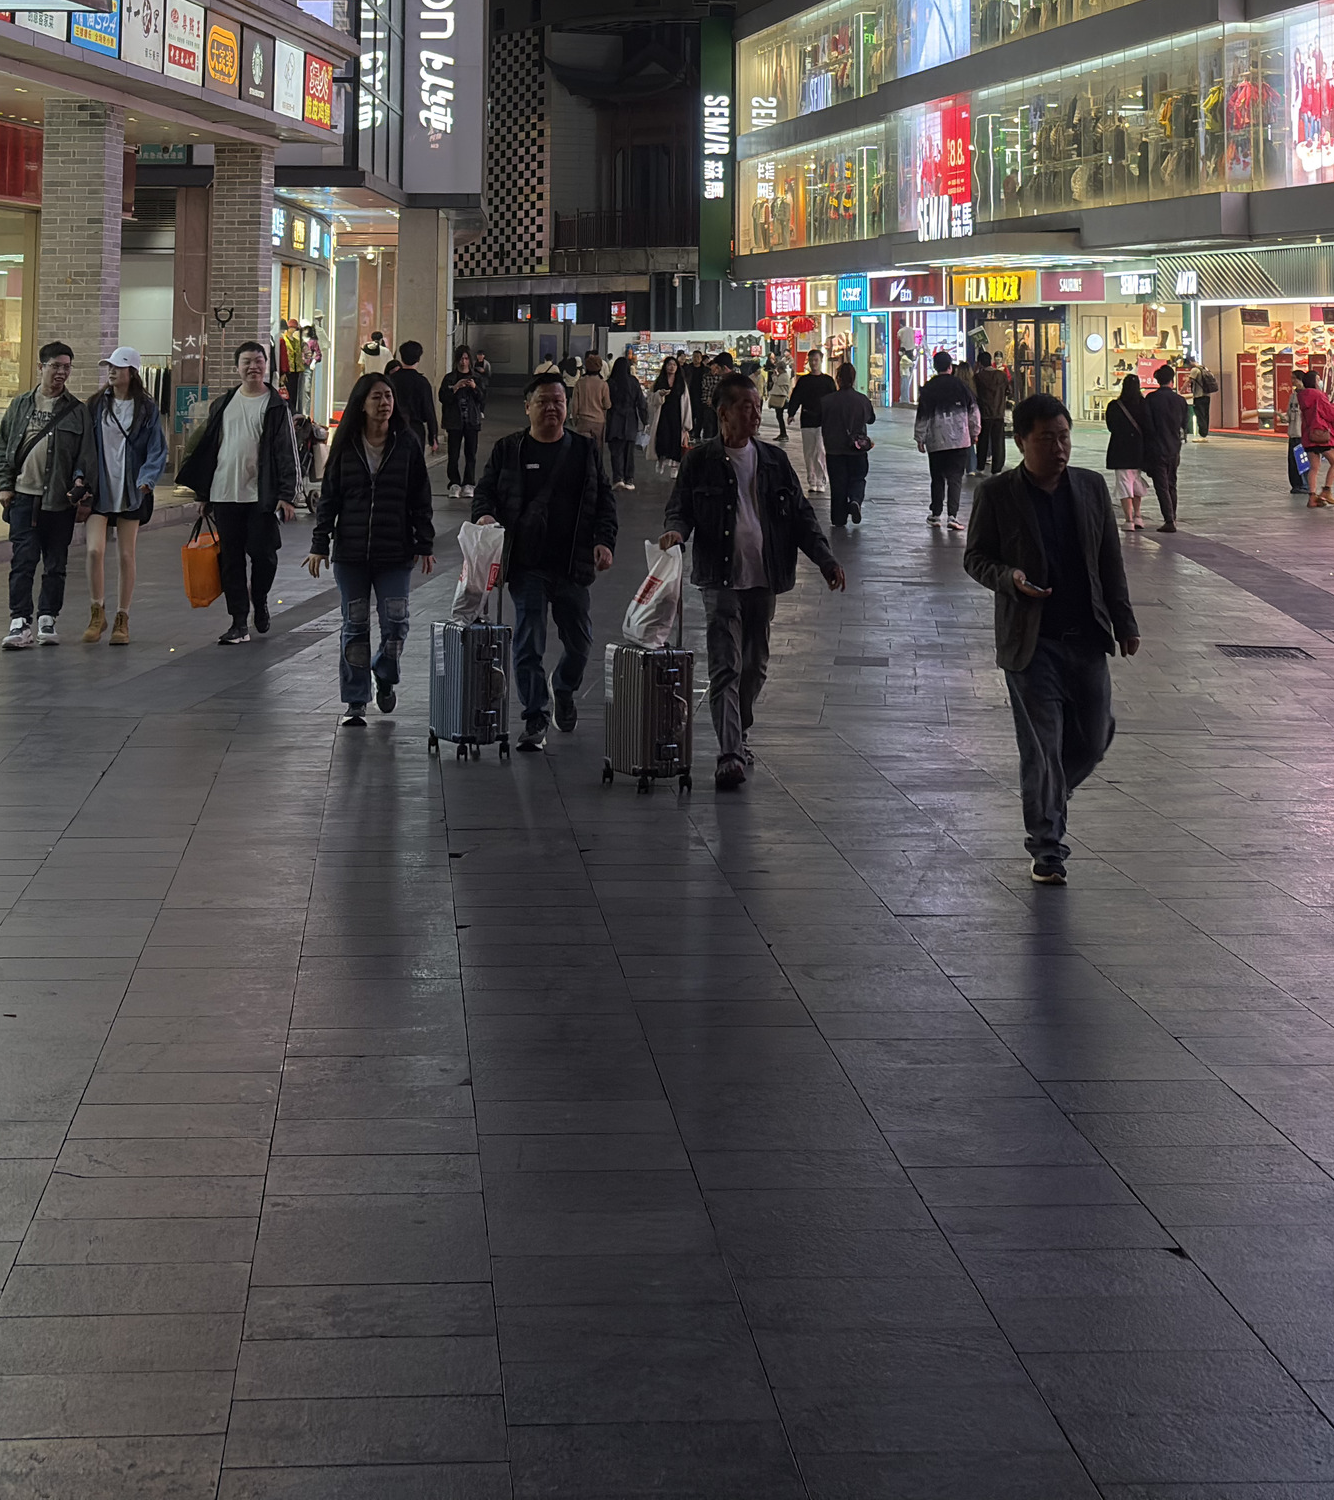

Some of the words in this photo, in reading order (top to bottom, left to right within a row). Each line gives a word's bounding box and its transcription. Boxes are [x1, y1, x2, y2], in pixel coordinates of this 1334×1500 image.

[703, 94, 730, 156] SEMIR
[917, 194, 951, 243] SEMIR
[964, 276, 987, 302] HLA
